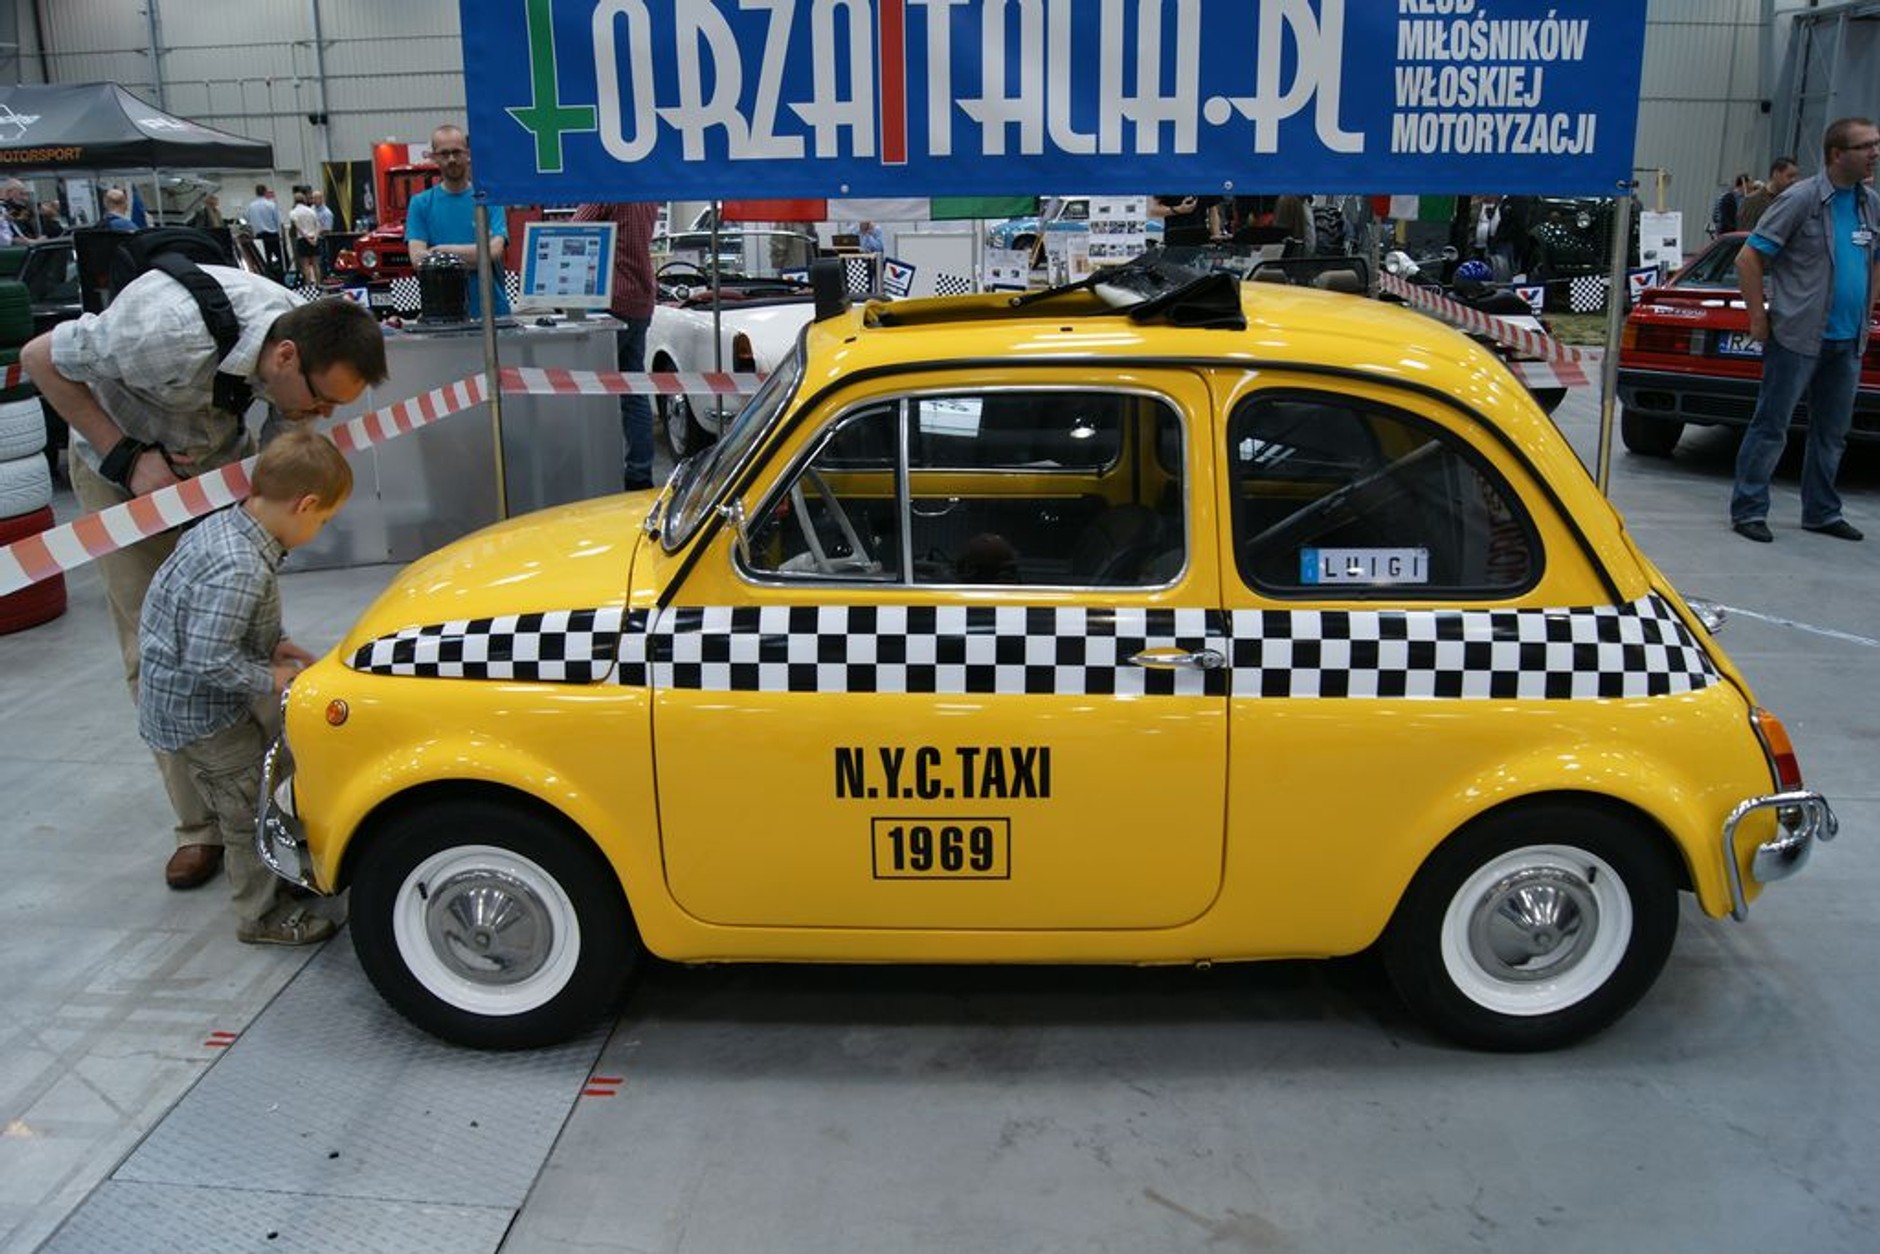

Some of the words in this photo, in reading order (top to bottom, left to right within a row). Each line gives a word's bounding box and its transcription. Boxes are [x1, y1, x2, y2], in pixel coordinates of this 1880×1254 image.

[1397, 9, 1589, 61] MIŁOŚNIKÓW
[1395, 66, 1543, 108] WŁOSKIEJ
[1391, 112, 1597, 154] MOTORYZACJI
[1325, 556, 1418, 578] LUIGI
[888, 826, 993, 872] 1969
